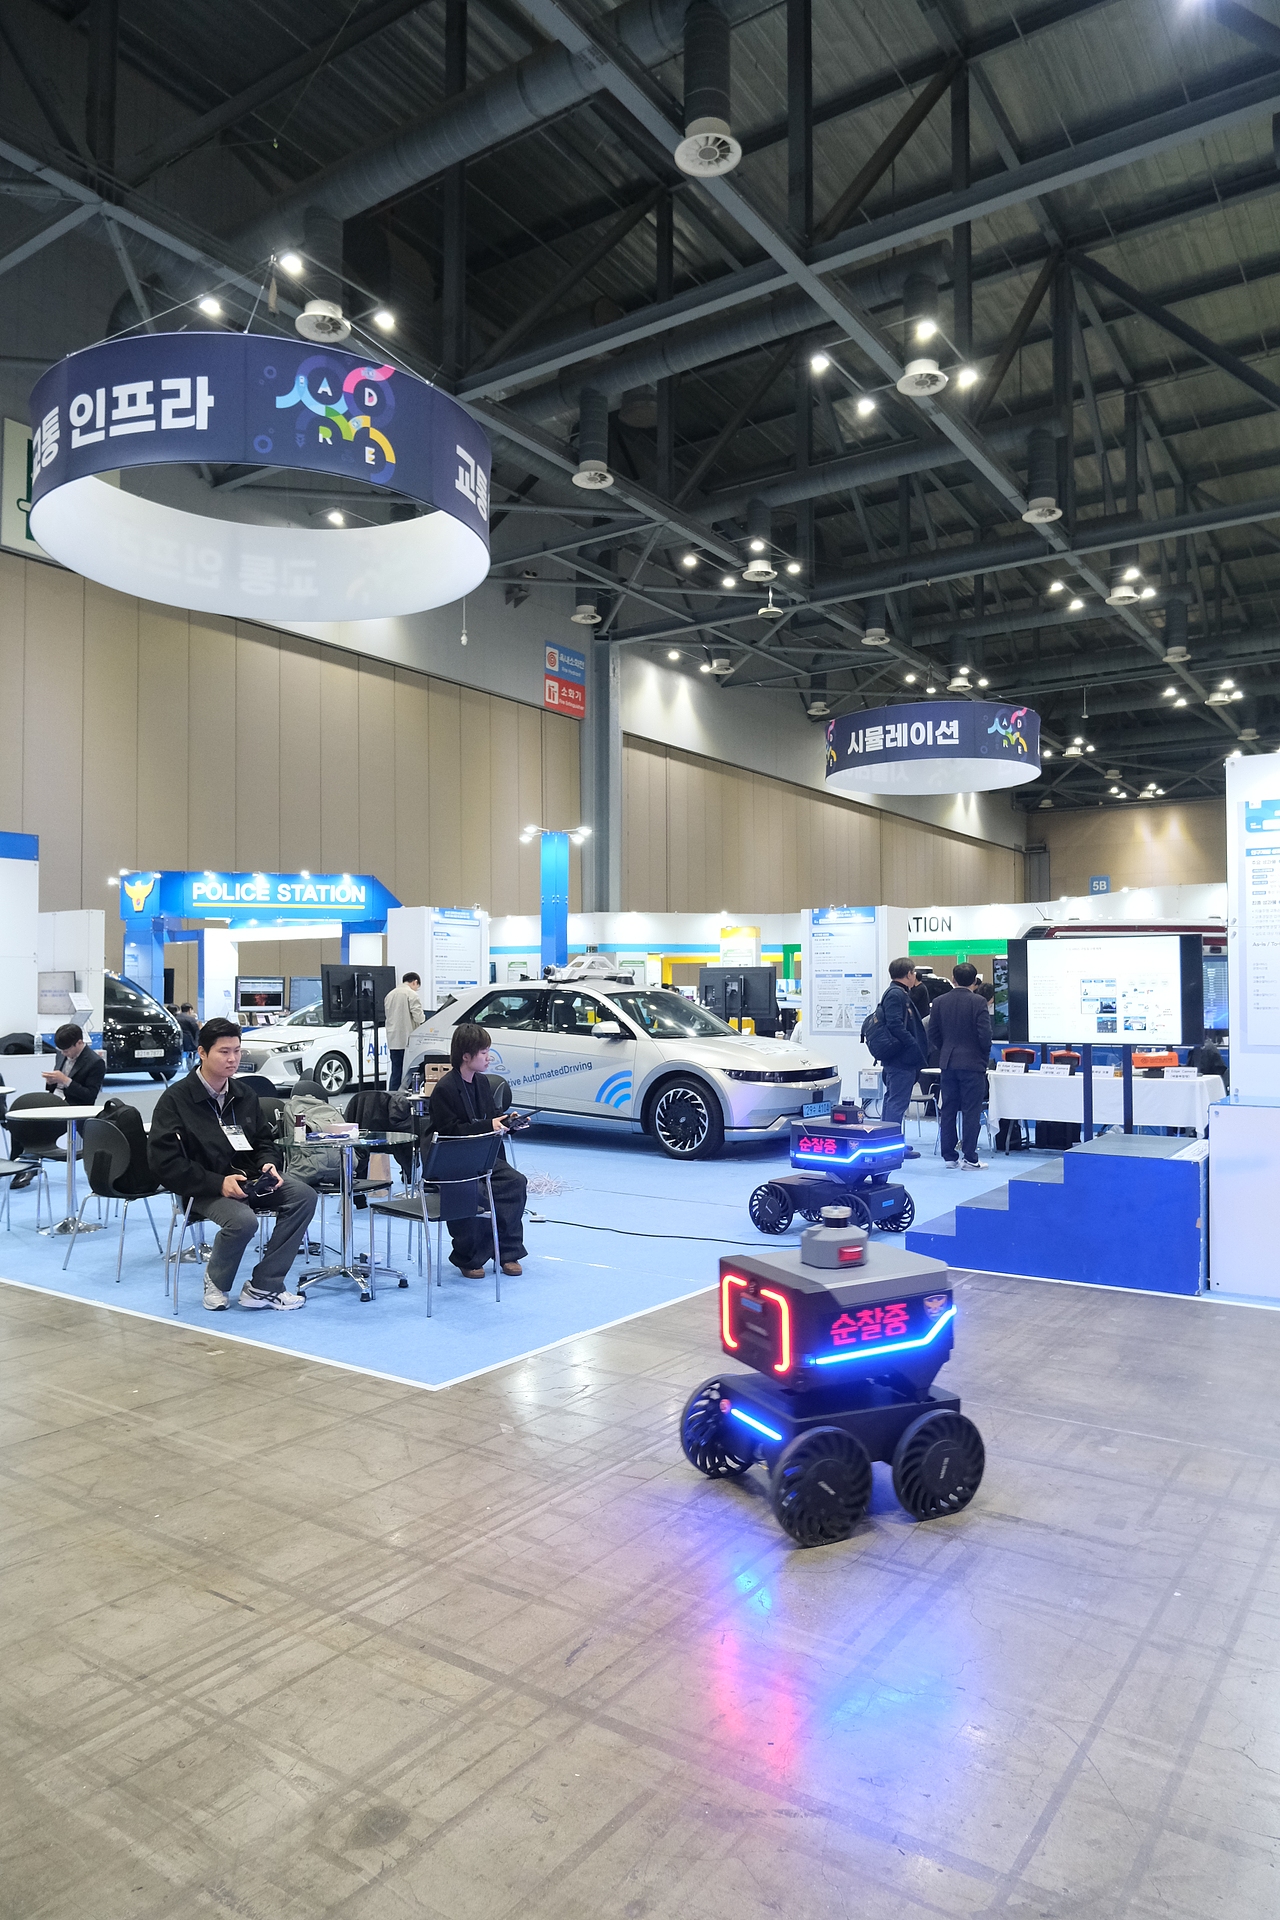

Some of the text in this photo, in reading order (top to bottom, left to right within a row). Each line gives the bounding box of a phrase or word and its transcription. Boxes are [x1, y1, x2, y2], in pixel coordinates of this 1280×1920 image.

[69, 375, 215, 450] 인프라
[561, 687, 582, 702] 소화기
[847, 720, 960, 755] 시뮬레이션
[192, 882, 366, 903] POLICE STATION
[1092, 880, 1107, 891] 5B
[908, 916, 952, 933] TION
[523, 1061, 593, 1084] AutomatedDriving
[799, 1136, 837, 1155] 순찰중
[830, 1303, 910, 1346] 순찰중
